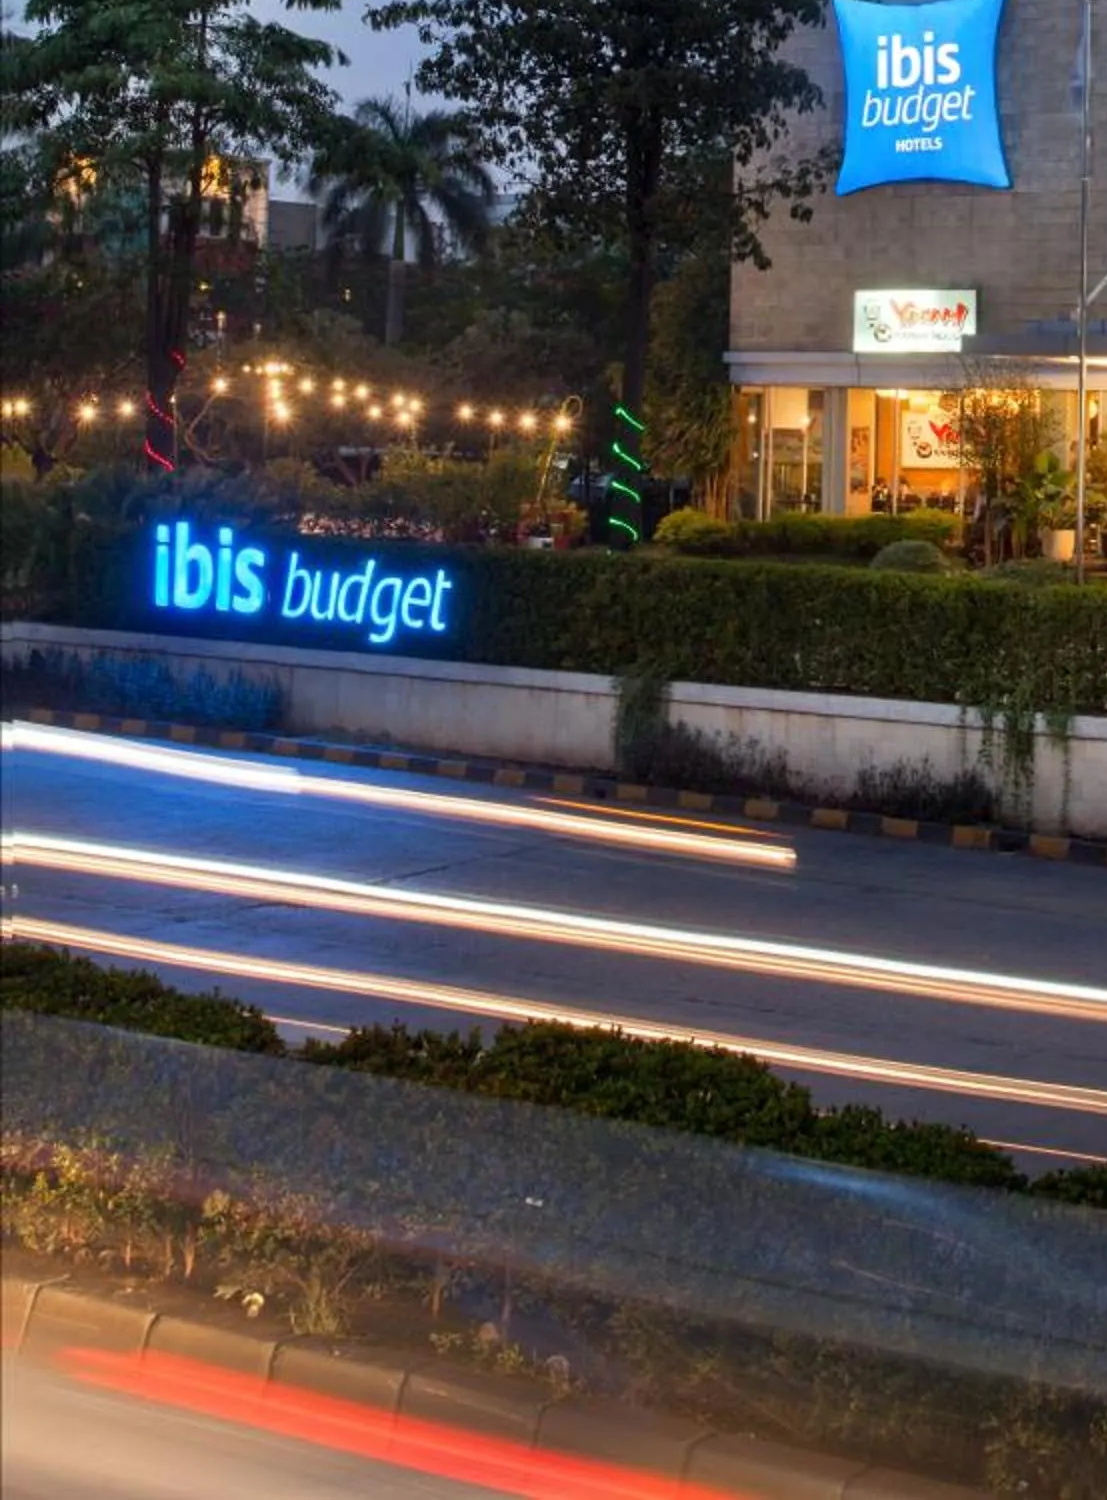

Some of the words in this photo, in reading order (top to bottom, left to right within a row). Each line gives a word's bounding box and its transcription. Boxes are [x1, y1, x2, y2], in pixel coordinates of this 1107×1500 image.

[876, 30, 962, 90] ibis
[861, 83, 975, 132] budget
[895, 136, 943, 153] HOTELS
[155, 520, 265, 613] ibis
[281, 551, 453, 643] budget
